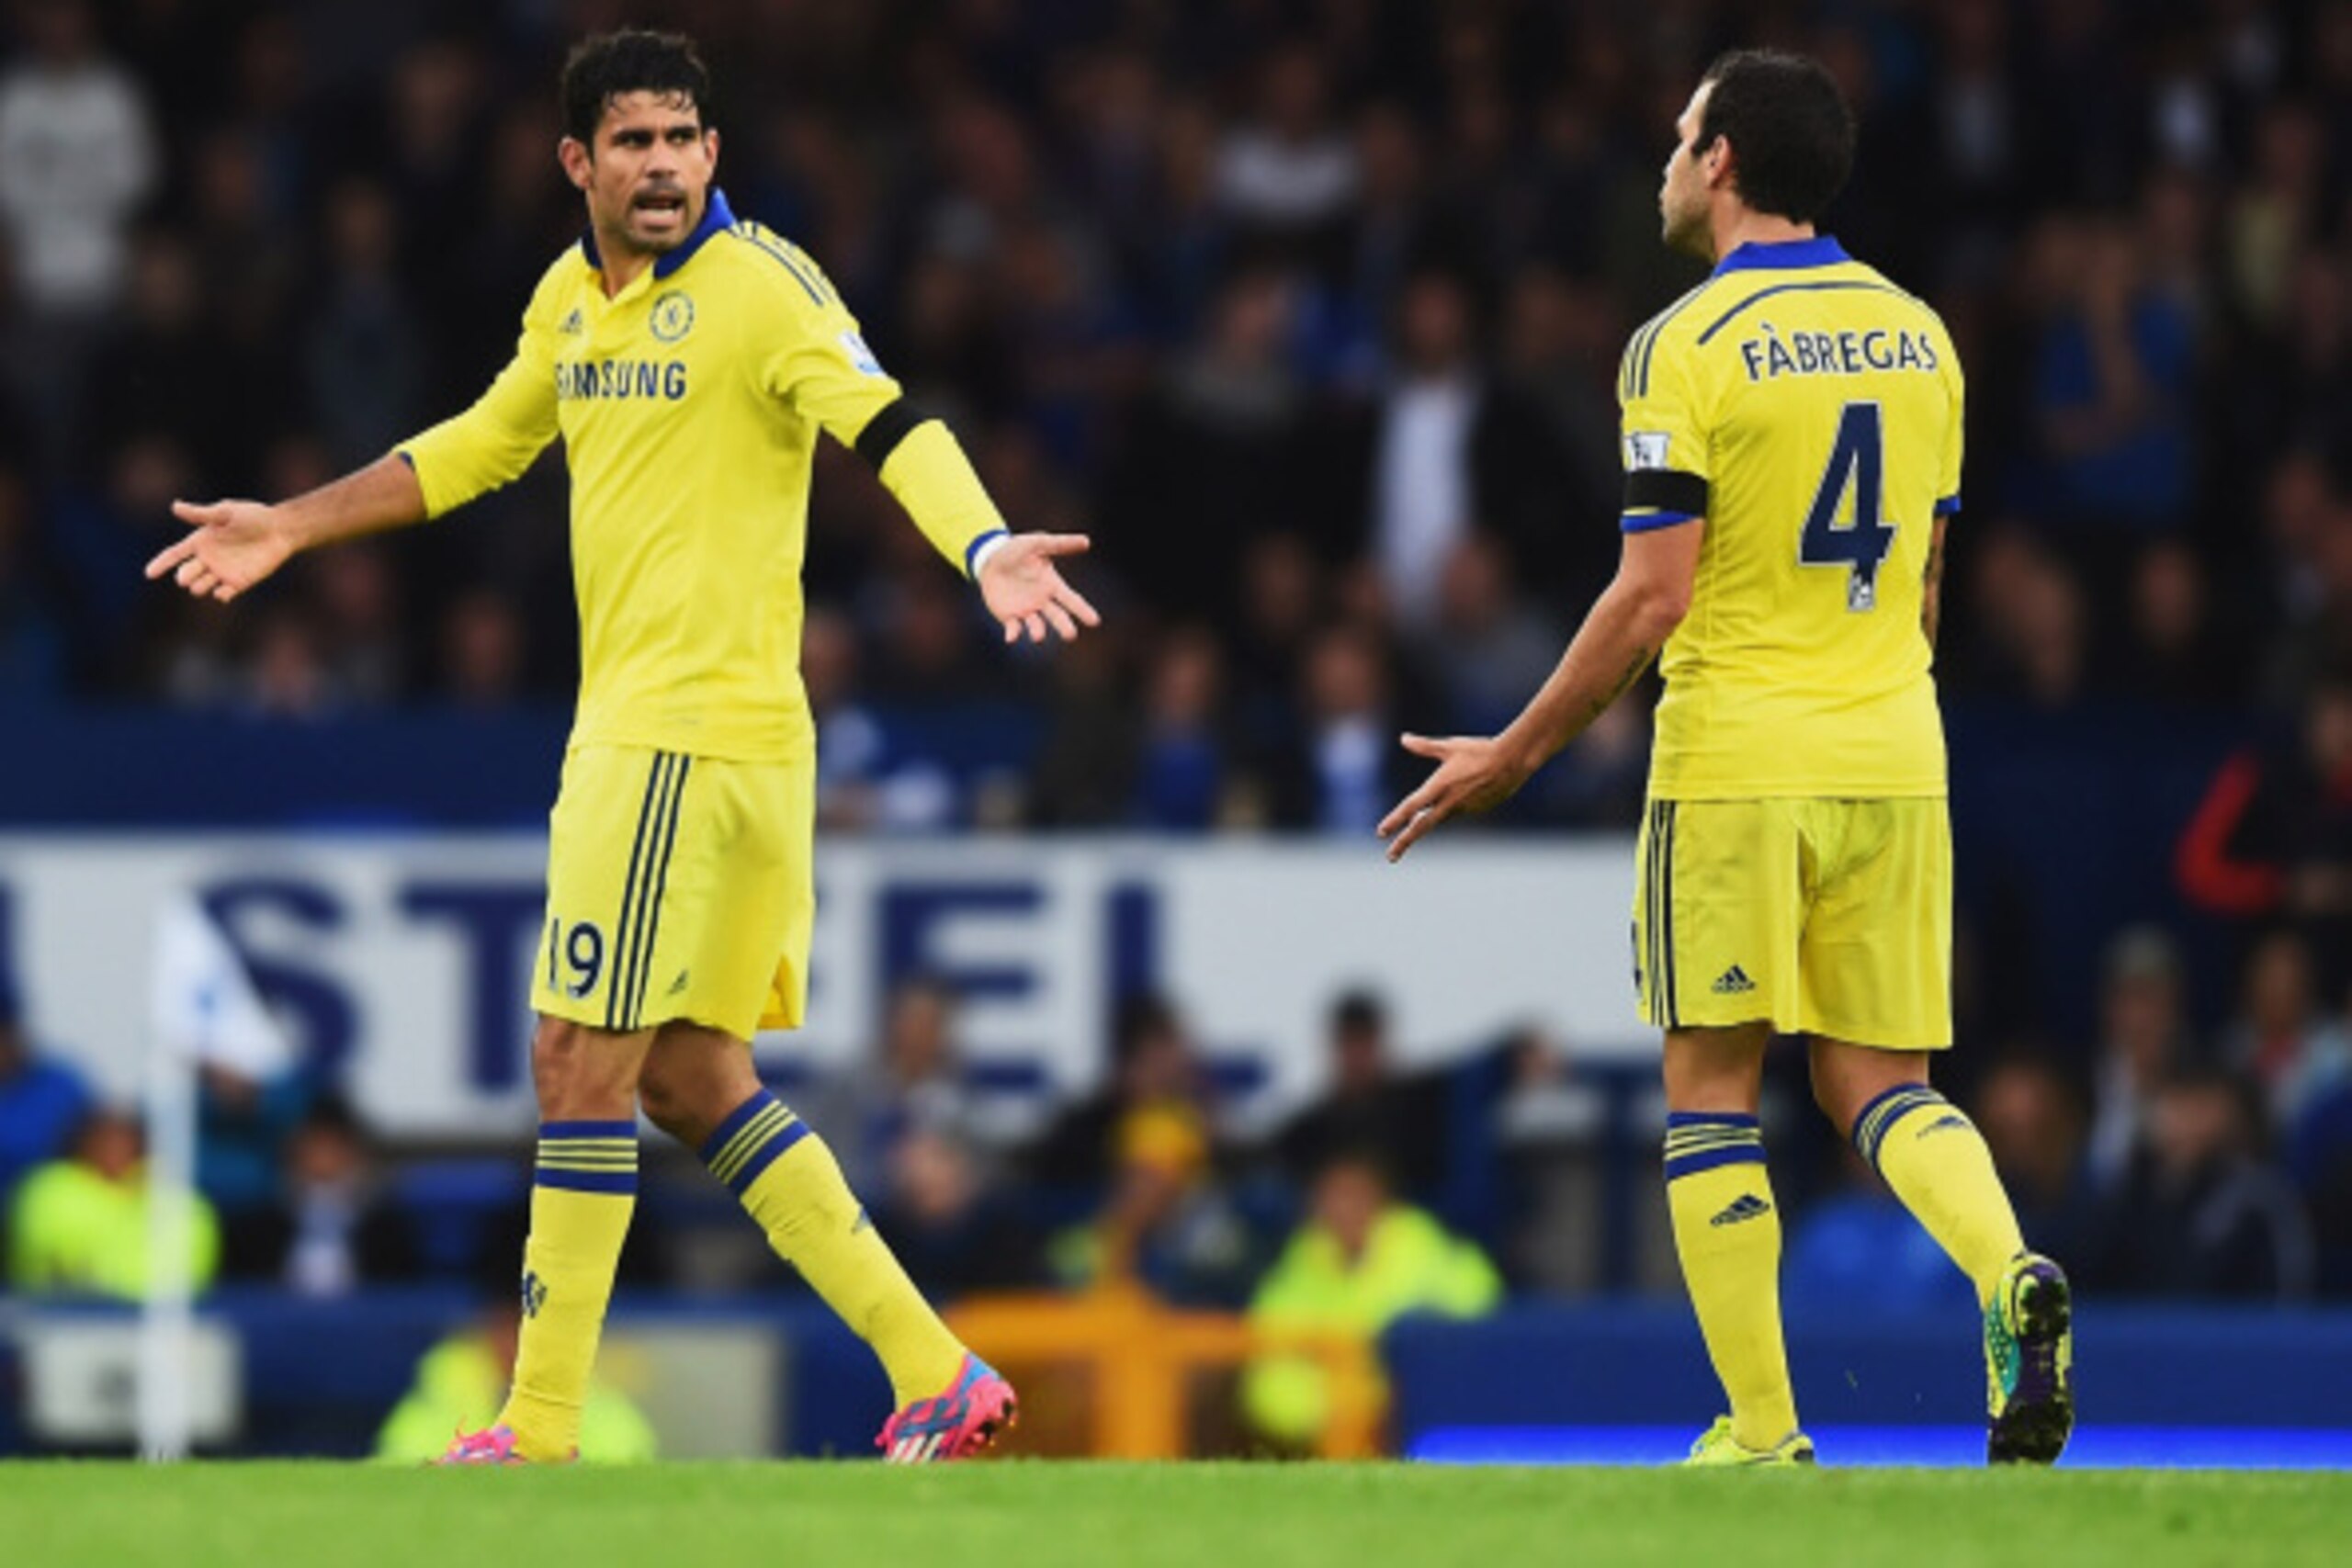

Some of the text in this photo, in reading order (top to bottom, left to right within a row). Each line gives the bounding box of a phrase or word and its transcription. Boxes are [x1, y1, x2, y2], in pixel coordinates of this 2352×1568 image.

[1740, 321, 1939, 382] FÀBREGAS
[1798, 400, 1899, 613] 4
[195, 877, 1274, 1100] STEL
[548, 916, 605, 1000] 19
